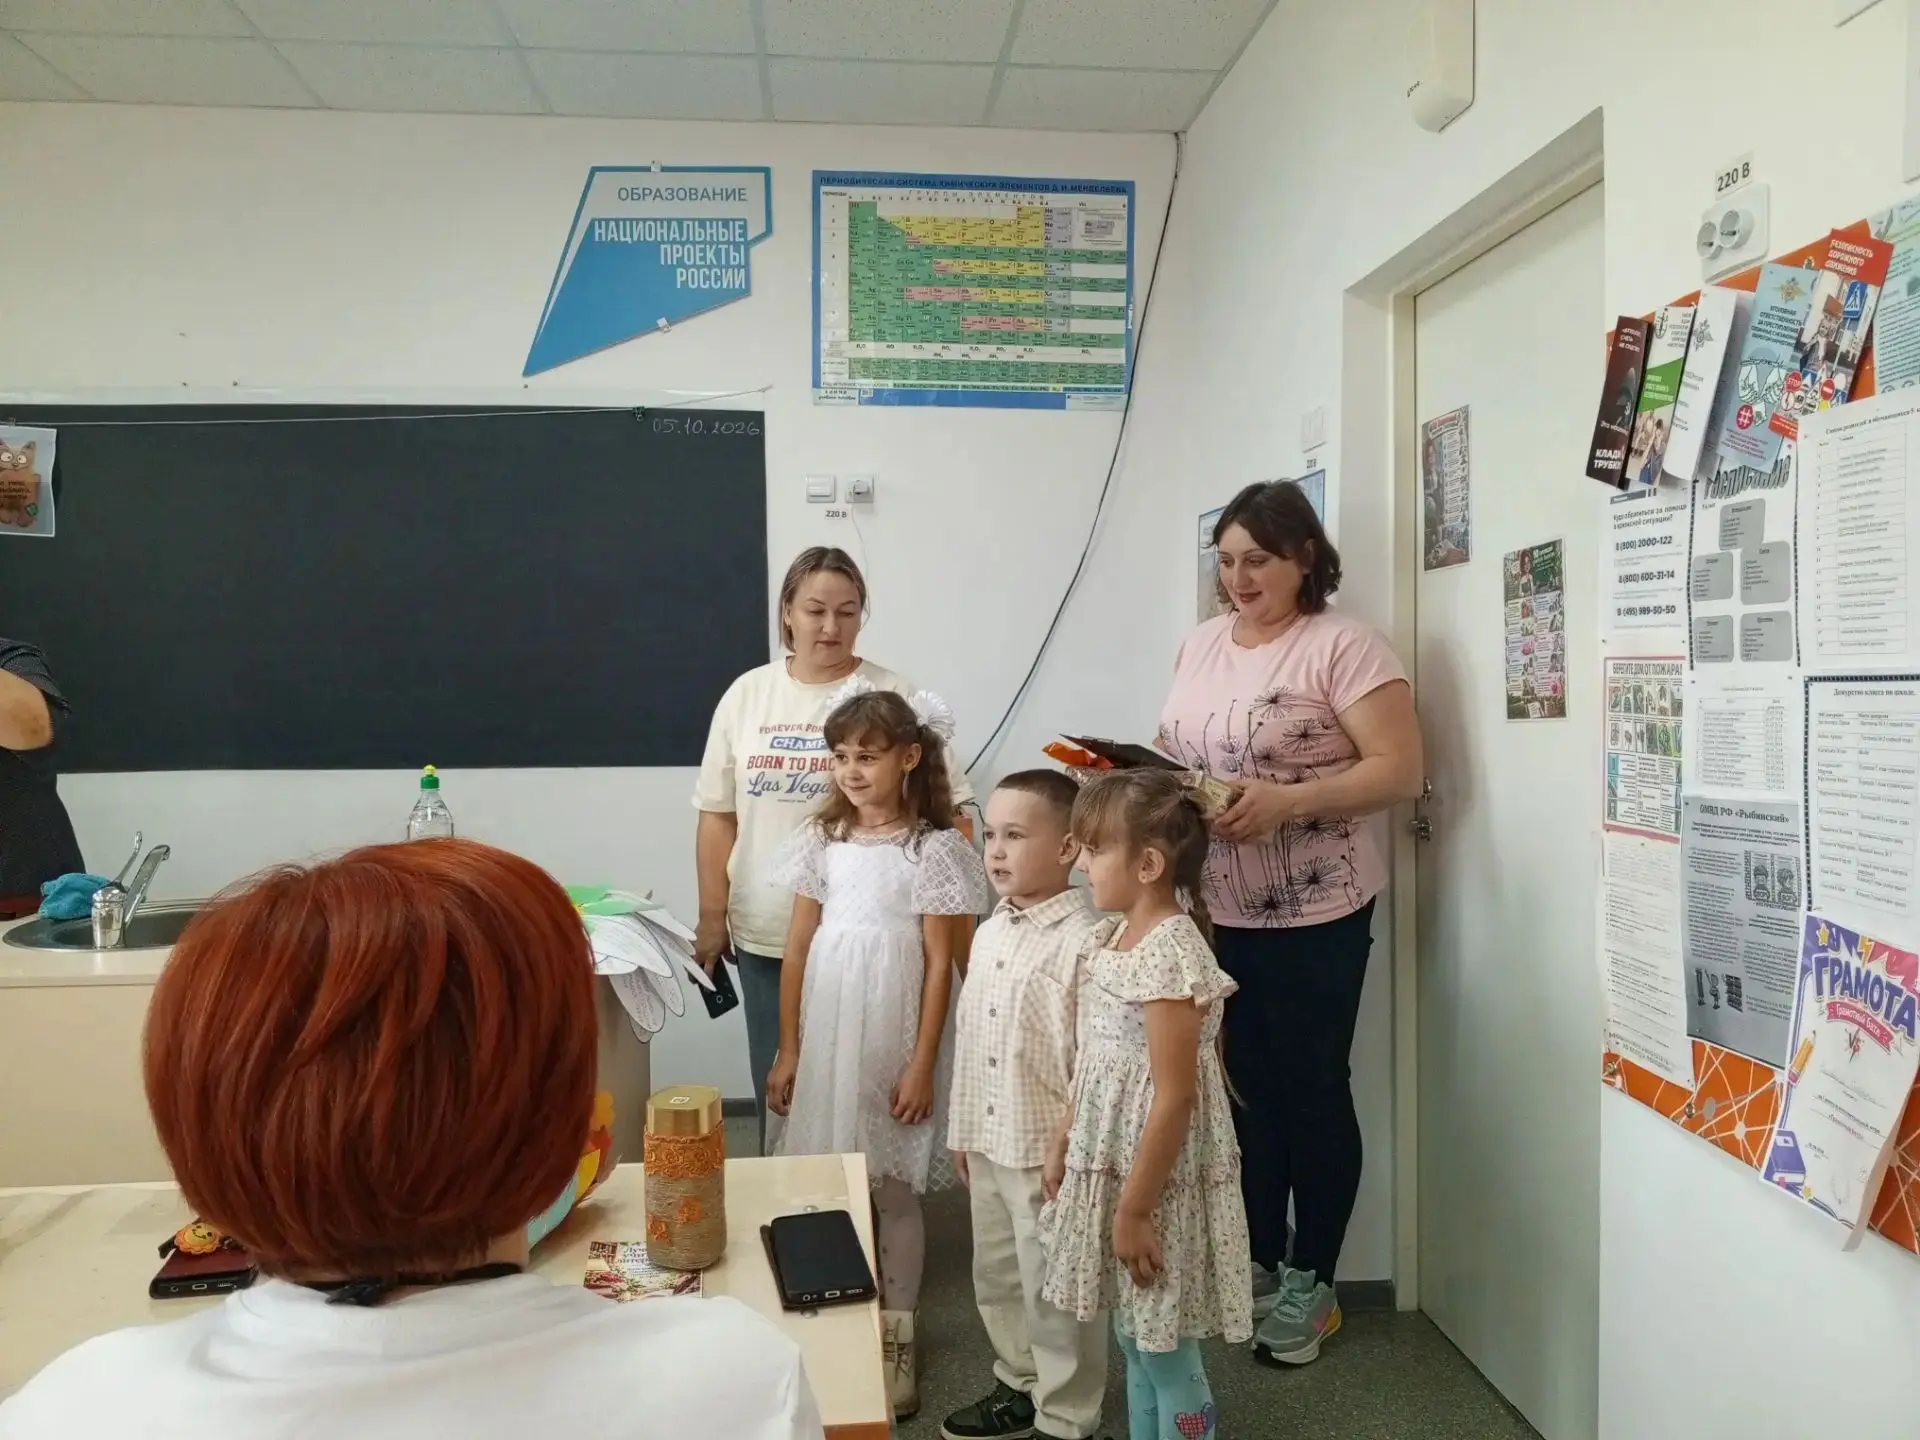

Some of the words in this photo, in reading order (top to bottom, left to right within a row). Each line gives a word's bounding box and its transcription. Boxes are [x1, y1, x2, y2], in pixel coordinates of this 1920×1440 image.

[820, 177, 894, 186] ПЕРИОДИЧЕСКАЯ
[897, 178, 936, 187] СИСТЕМА
[940, 180, 996, 189] ХИМИЧЕСКИХ
[1000, 181, 1050, 191] ЭЛЕМЕНТОВ
[1717, 168, 1739, 192] 220
[617, 187, 748, 202] ОБРАЗОВАНИЕ
[594, 220, 745, 243] НАЦИОНАЛЬНЫЕ
[660, 244, 745, 266] ПРОЕКТЫ
[676, 268, 746, 289] РОССИИ
[1637, 535, 1673, 548] 2000-122
[1641, 570, 1675, 581] 600-31-14
[1623, 607, 1638, 617] (495)
[1638, 604, 1676, 616] 989-50-50
[759, 723, 803, 734] FOREVER
[746, 755, 785, 770] BORN
[789, 757, 807, 771] TO
[809, 757, 836, 772] RAC
[747, 771, 783, 797] Las
[784, 770, 833, 799] Vega
[1699, 803, 1719, 816] ОМВД
[1720, 806, 1733, 816] РФ
[1735, 809, 1789, 823] «Рыбинский»
[1813, 956, 1917, 1039] ГРАМОТА
[1836, 1004, 1866, 1024] Грамотный
